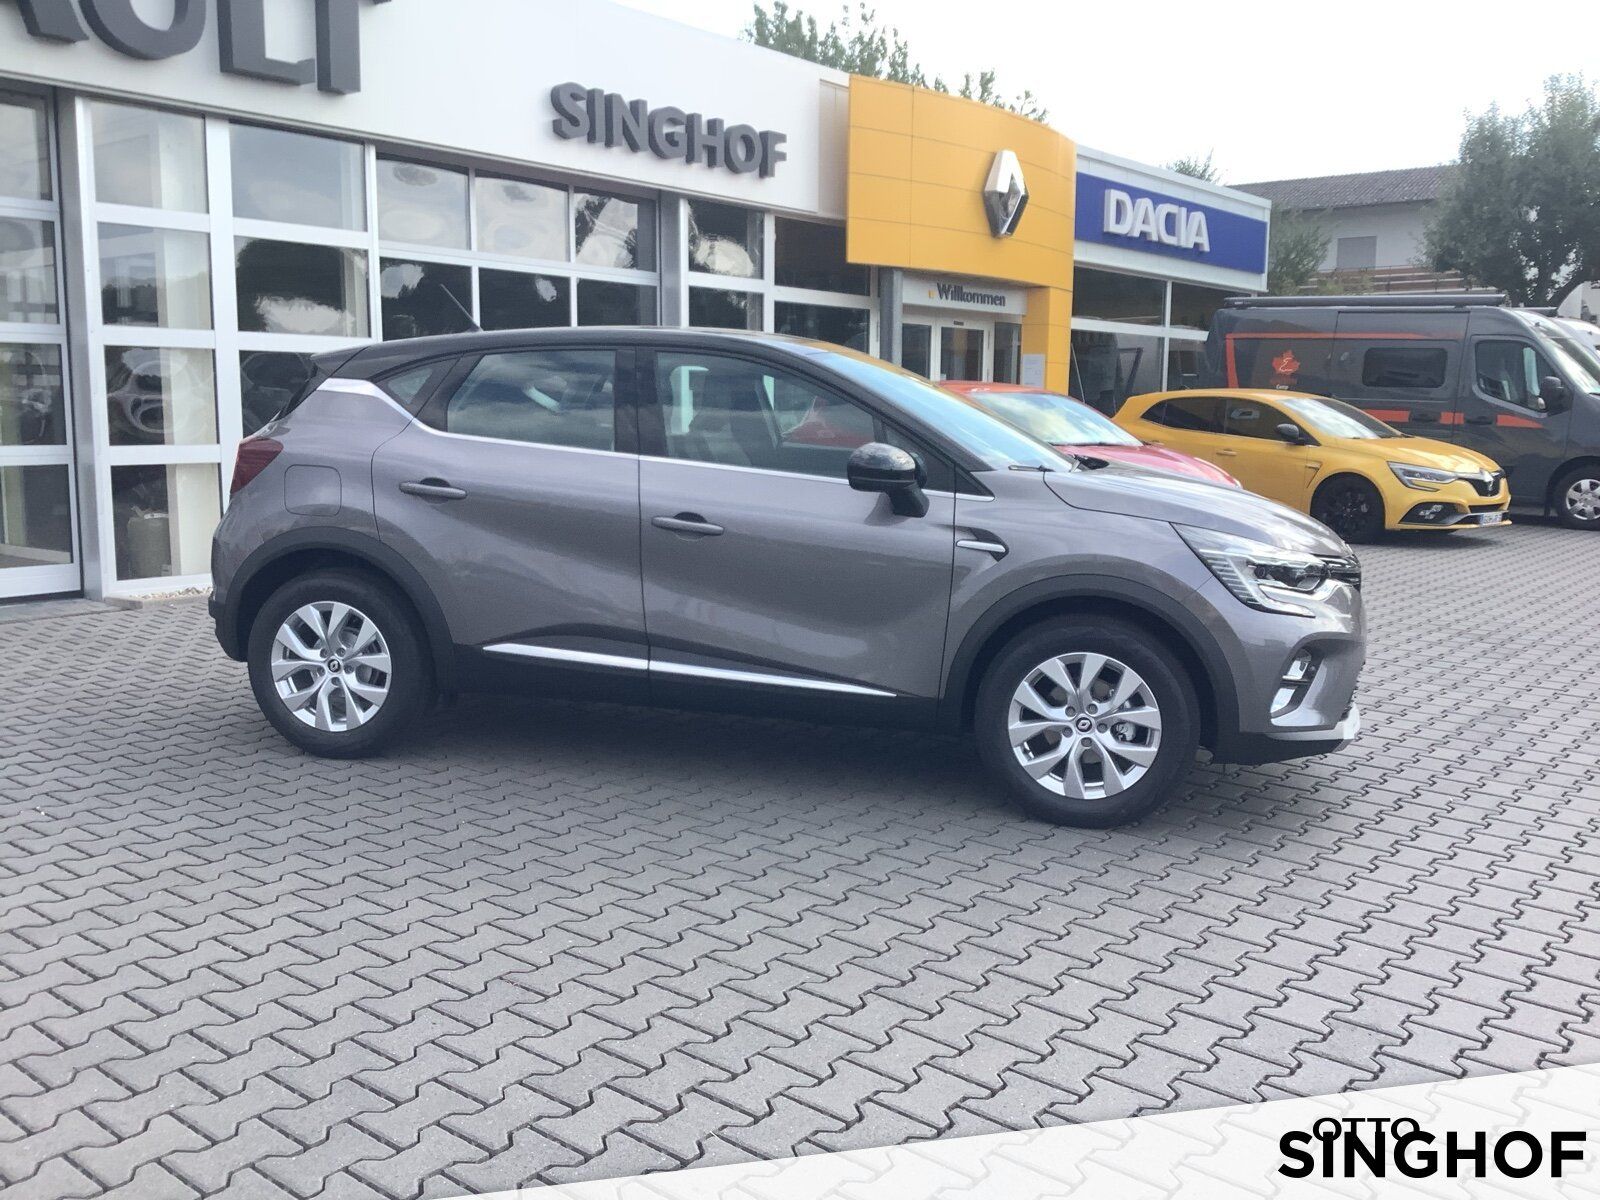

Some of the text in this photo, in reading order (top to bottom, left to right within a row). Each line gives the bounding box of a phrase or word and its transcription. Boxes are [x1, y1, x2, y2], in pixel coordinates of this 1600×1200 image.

[551, 81, 787, 178] SINGHOF
[1103, 188, 1210, 252] DACIA
[936, 282, 1006, 307] Willkommen
